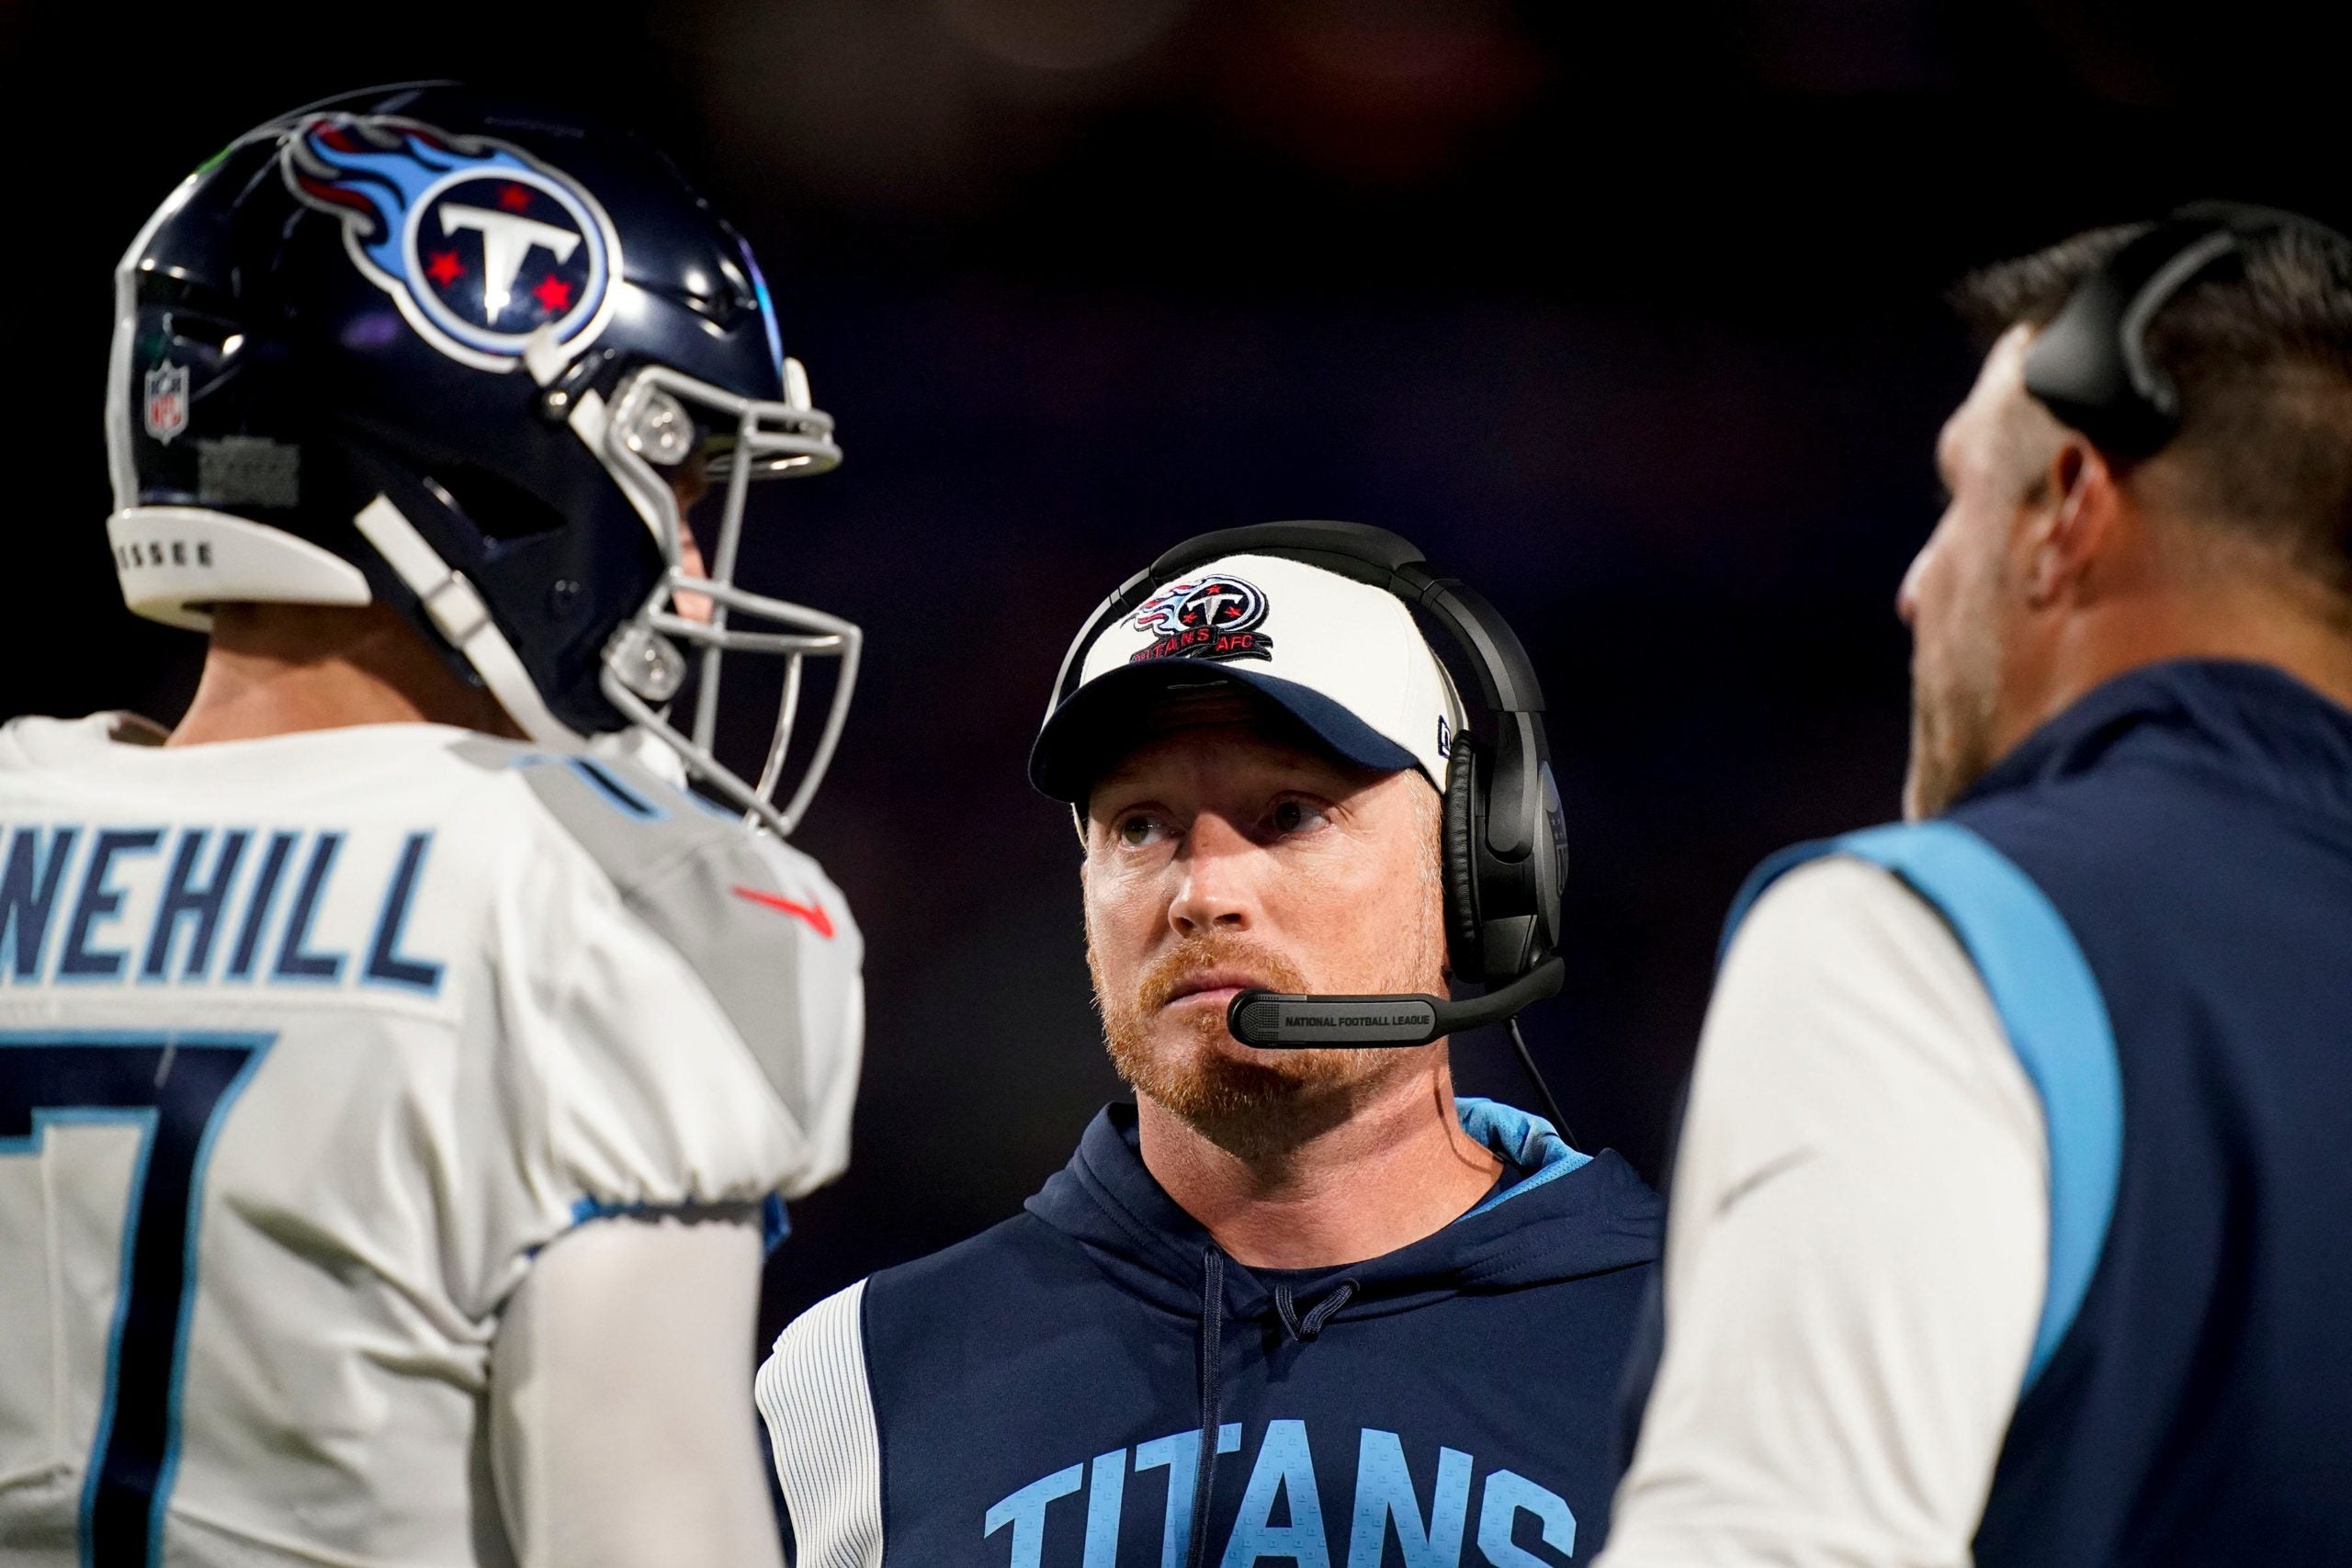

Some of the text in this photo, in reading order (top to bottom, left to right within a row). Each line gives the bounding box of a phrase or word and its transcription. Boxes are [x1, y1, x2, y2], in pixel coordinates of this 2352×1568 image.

[439, 203, 581, 325] T
[1216, 635, 1252, 652] AFC
[1285, 1015, 1430, 1027] NATIONAL FOOTBALL LEAGUE
[984, 1419, 1577, 1568] TITANS
